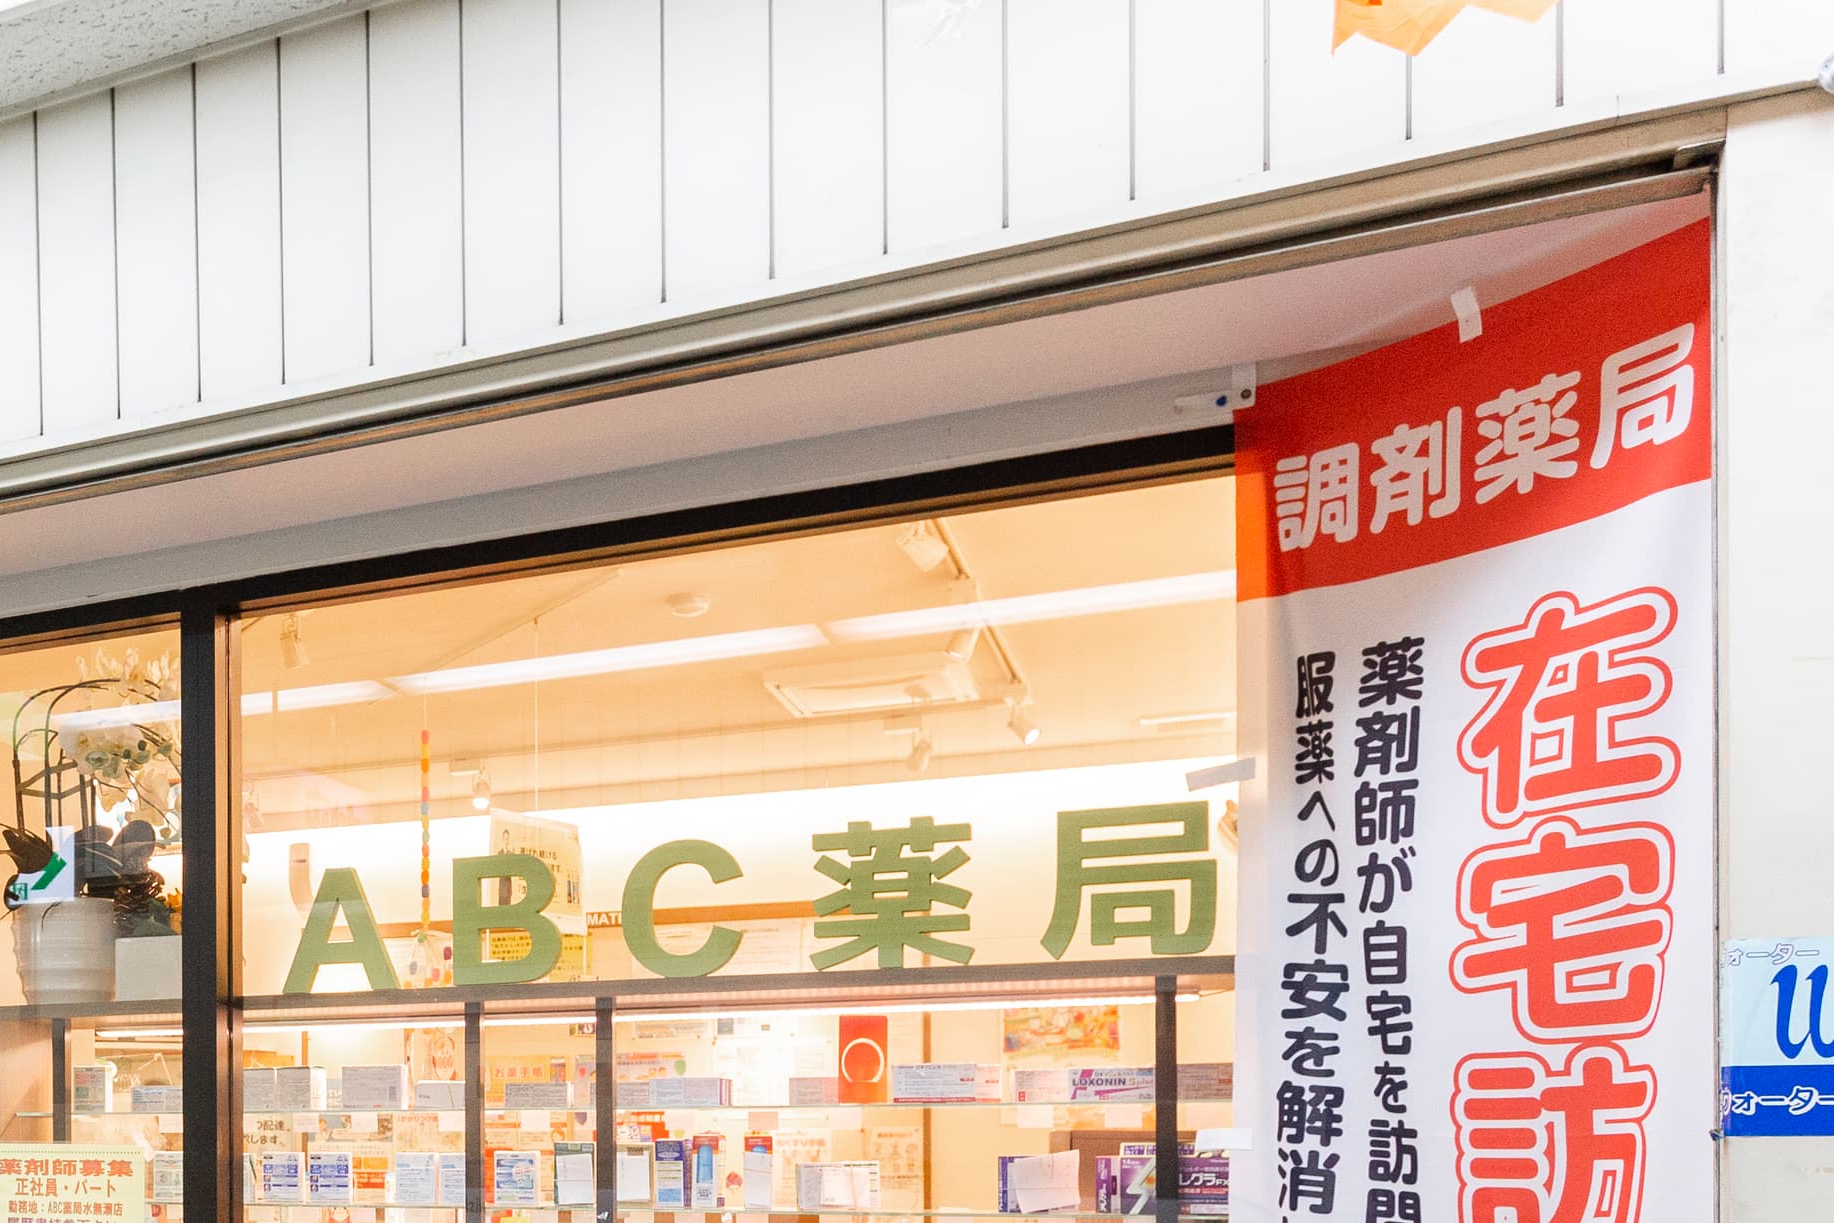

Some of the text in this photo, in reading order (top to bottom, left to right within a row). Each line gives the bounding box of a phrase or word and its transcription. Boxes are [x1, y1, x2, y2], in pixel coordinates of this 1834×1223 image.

[1274, 322, 1695, 554] 調剤薬局
[283, 799, 1219, 995] ABC薬局
[494, 1065, 544, 1079] お薬手帳
[1072, 1077, 1126, 1087] LOXONIN
[15, 1178, 117, 1198] 正社員・パート
